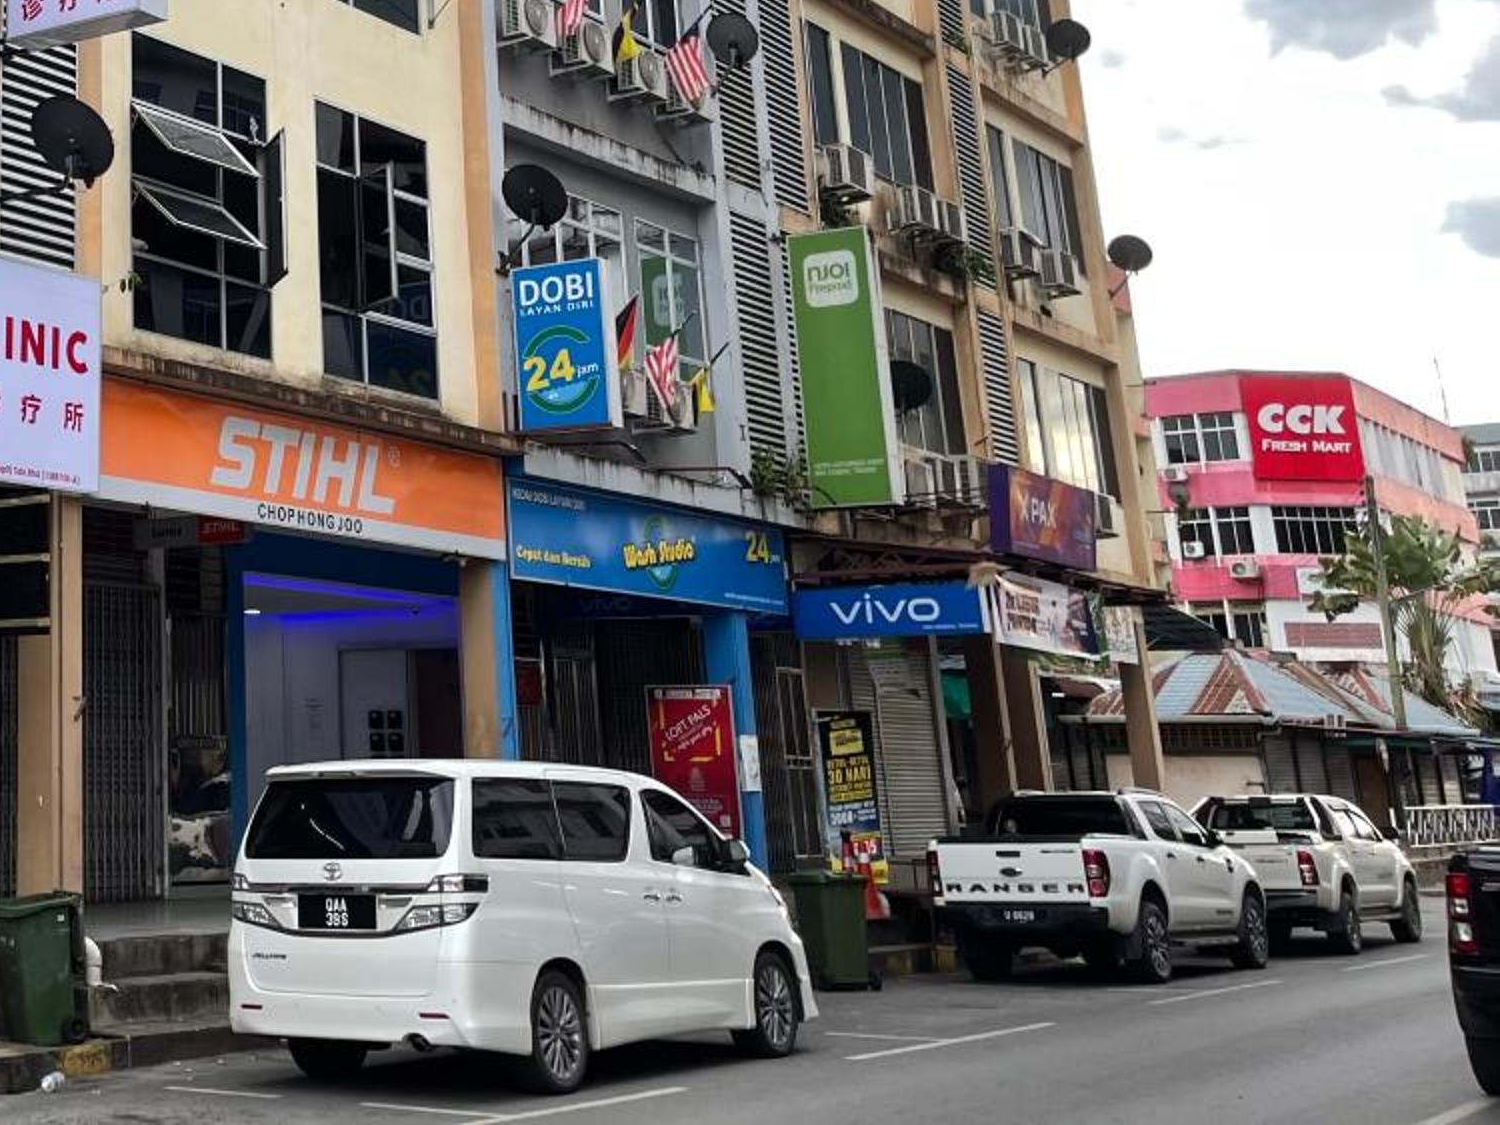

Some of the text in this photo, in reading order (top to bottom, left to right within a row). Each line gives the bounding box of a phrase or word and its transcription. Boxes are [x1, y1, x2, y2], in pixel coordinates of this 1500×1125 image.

[519, 272, 593, 306] DOBI
[519, 300, 594, 317] LAYAN DIRI
[523, 348, 599, 391] 24 jam
[1257, 403, 1347, 434] CCK
[210, 415, 397, 515] STIHL
[622, 538, 695, 569] Wash Studio
[744, 531, 770, 565] 24
[829, 592, 940, 624] vivo
[827, 768, 843, 784] 30
[946, 883, 1085, 893] RANGER
[325, 897, 348, 912] QAA
